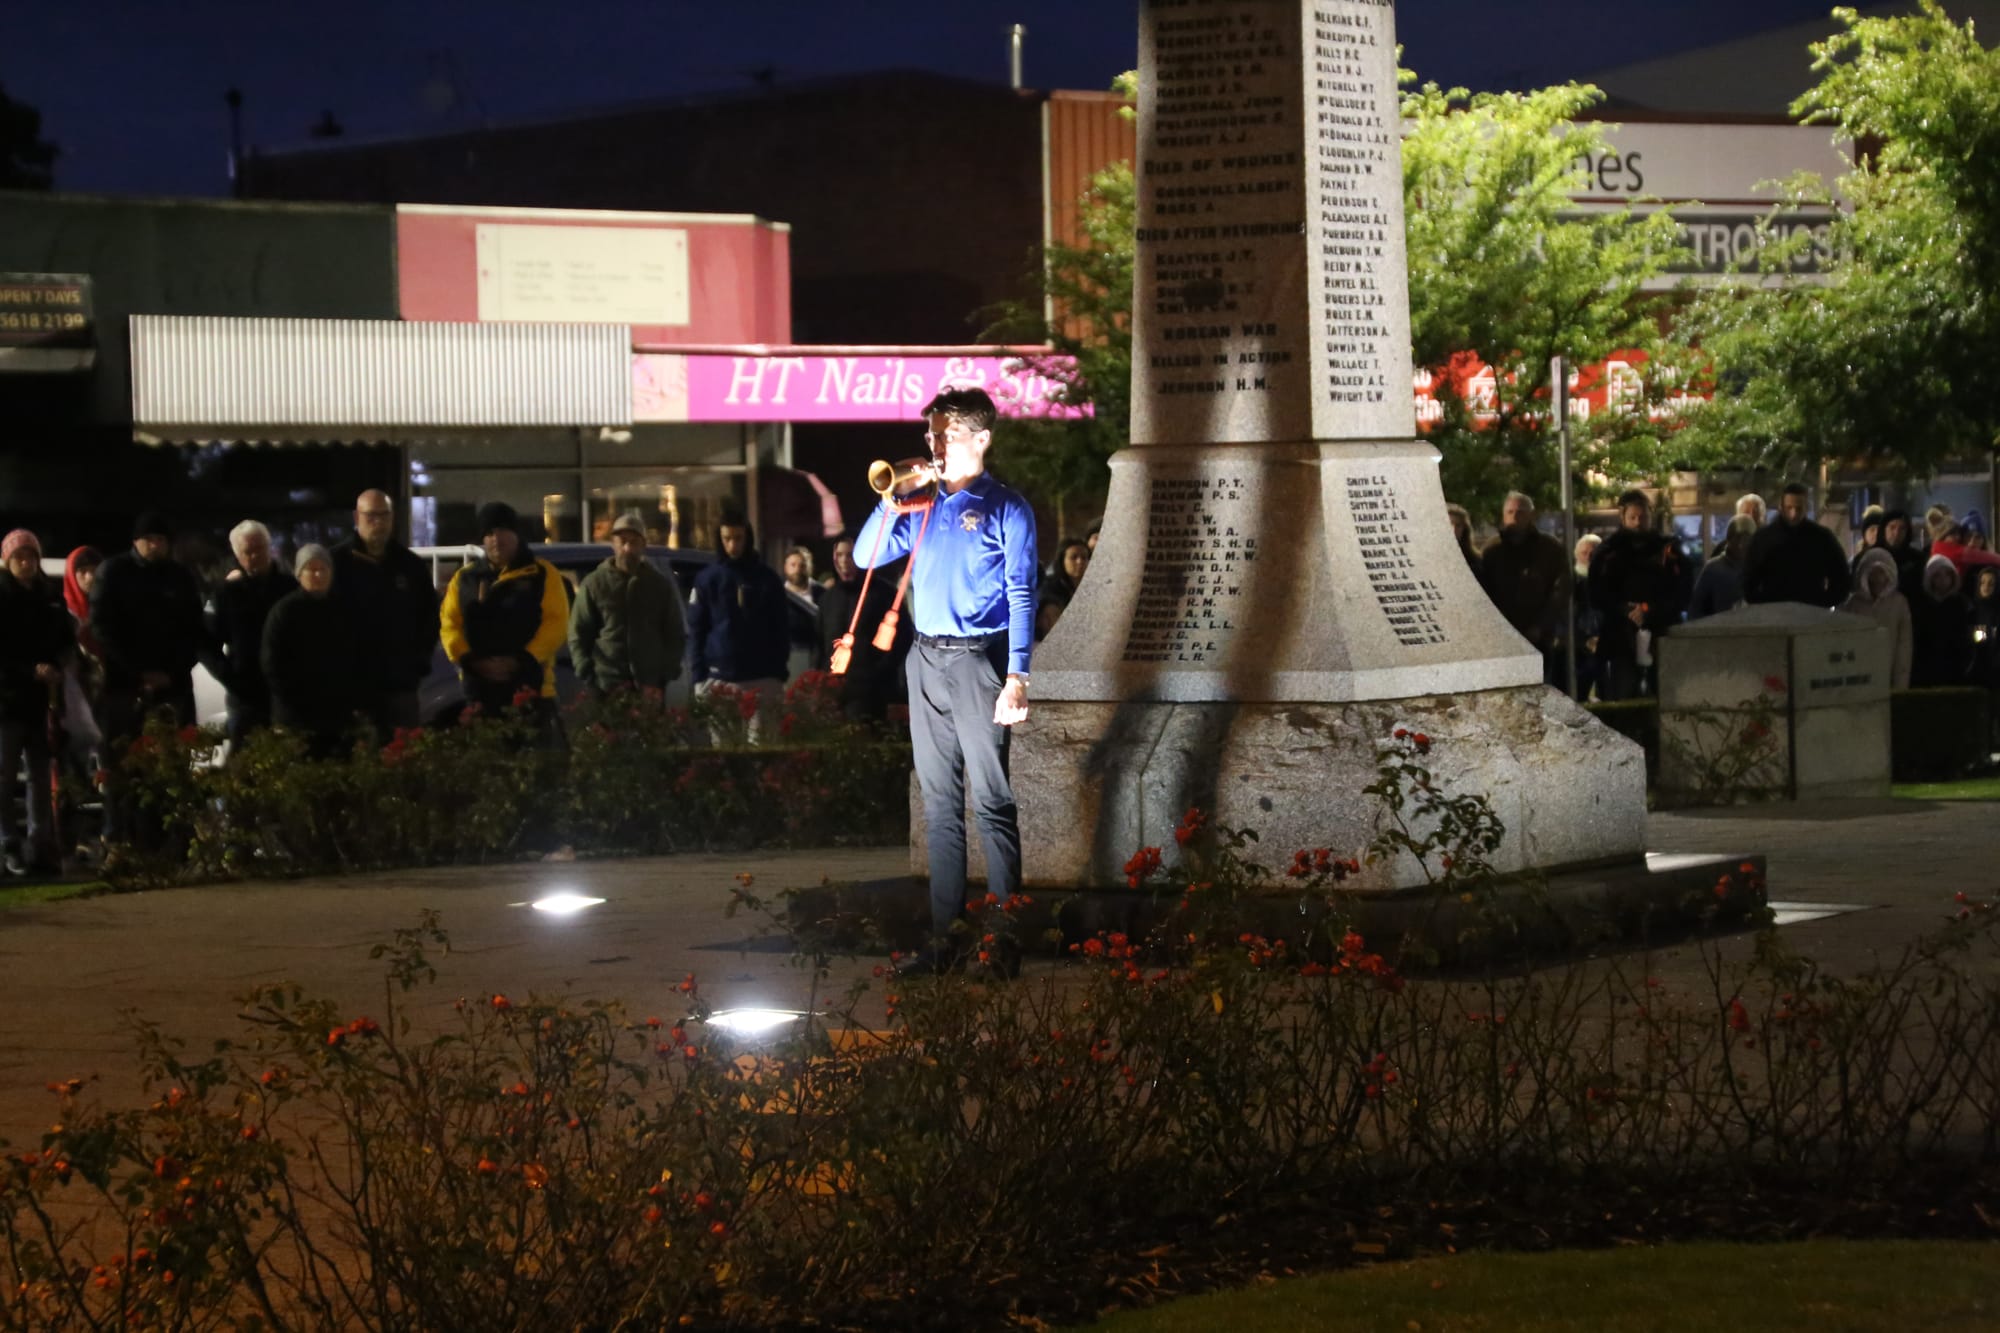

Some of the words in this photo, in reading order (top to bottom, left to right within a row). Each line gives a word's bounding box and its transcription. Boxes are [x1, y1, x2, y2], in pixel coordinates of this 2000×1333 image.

[1320, 177, 1348, 190] PAYNE
[0, 290, 32, 304] PEN
[45, 290, 80, 304] DAYS
[1164, 326, 1231, 341] KOREAN
[1242, 323, 1277, 337] WAR
[1326, 324, 1378, 336] TATTERSON
[1213, 353, 1228, 365] IN
[1239, 351, 1291, 364] ACTION
[1328, 358, 1368, 370] WALLACE
[725, 357, 805, 405] HT
[814, 357, 924, 405] Nails
[1329, 375, 1364, 386] WALKER
[1330, 390, 1363, 402] WRIGHT
